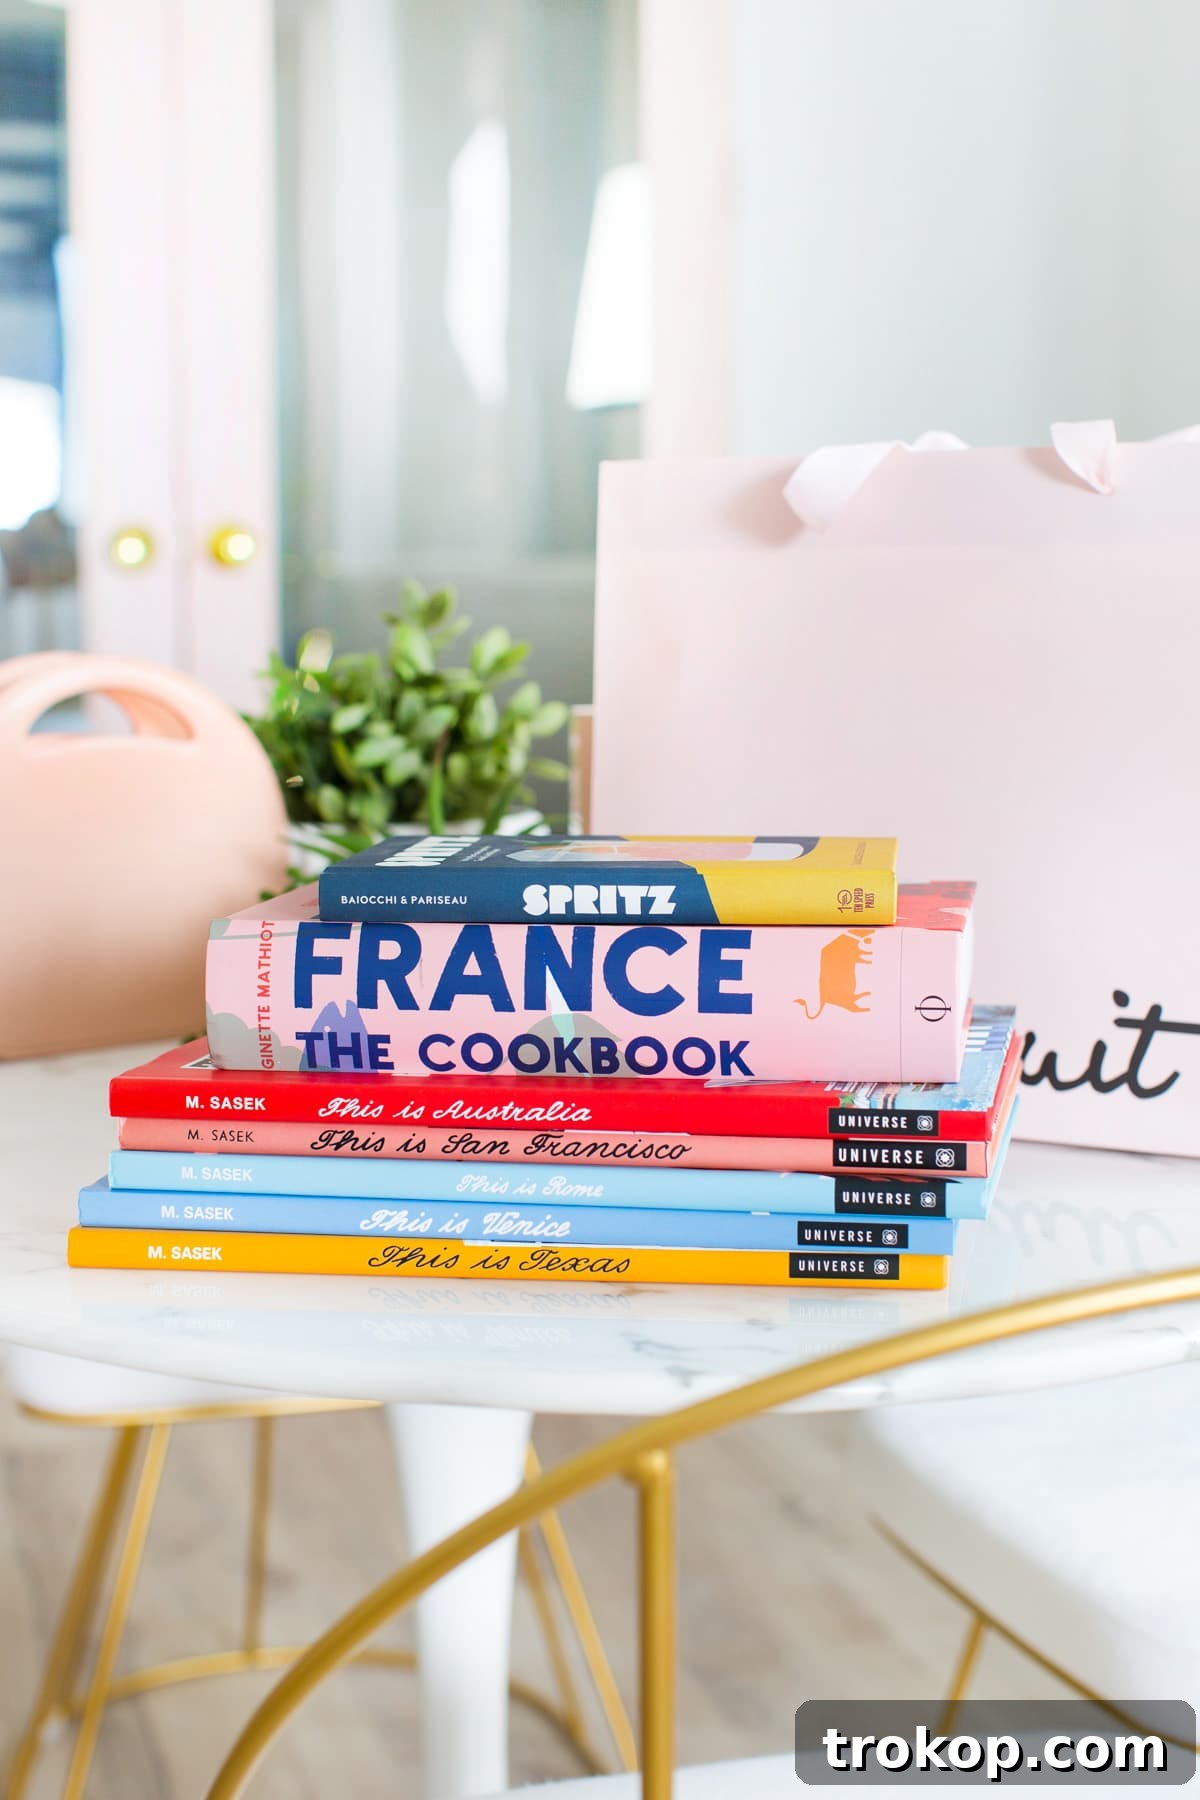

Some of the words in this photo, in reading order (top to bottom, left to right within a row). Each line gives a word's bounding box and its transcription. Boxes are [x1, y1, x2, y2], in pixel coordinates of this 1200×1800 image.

[340, 895, 397, 905] BAIOCCHI
[400, 895, 408, 905] &
[410, 895, 468, 905] PARISEAU
[523, 884, 676, 916] SPRITZ
[257, 920, 275, 998] MATHIOT
[295, 921, 752, 1016] FRANCE
[257, 1004, 275, 1070] GINETTE
[296, 1032, 394, 1069] THE
[419, 1033, 753, 1075] COOKBOOK
[186, 1096, 204, 1108] M.
[210, 1096, 265, 1110] SASEK
[319, 1098, 383, 1117] This
[393, 1101, 424, 1119] is
[433, 1101, 592, 1121] Australia
[838, 1115, 907, 1129] UNIVERSE
[187, 1129, 203, 1142] M.
[212, 1130, 253, 1142] SASEK
[311, 1130, 385, 1152] This
[396, 1134, 425, 1153] is
[442, 1133, 509, 1155] San
[524, 1134, 691, 1159] Francisco
[837, 1147, 924, 1165] UNIVERSE
[181, 1166, 197, 1180] M.
[202, 1168, 251, 1180] SASEK
[456, 1174, 506, 1194] This
[513, 1179, 536, 1196] is
[543, 1176, 603, 1196] Rome
[842, 1191, 911, 1206] UNIVERSE
[161, 1206, 179, 1219] M.
[184, 1207, 233, 1220] SASEK
[360, 1210, 432, 1232] This
[438, 1213, 469, 1233] is
[483, 1212, 570, 1237] Venice
[804, 1229, 873, 1243] UNIVERSE
[148, 1246, 165, 1258] M.
[172, 1247, 221, 1260] SASEK
[368, 1246, 459, 1268] This
[470, 1250, 510, 1270] is
[518, 1249, 631, 1274] Texas
[798, 1260, 865, 1273] UNIVERSE
